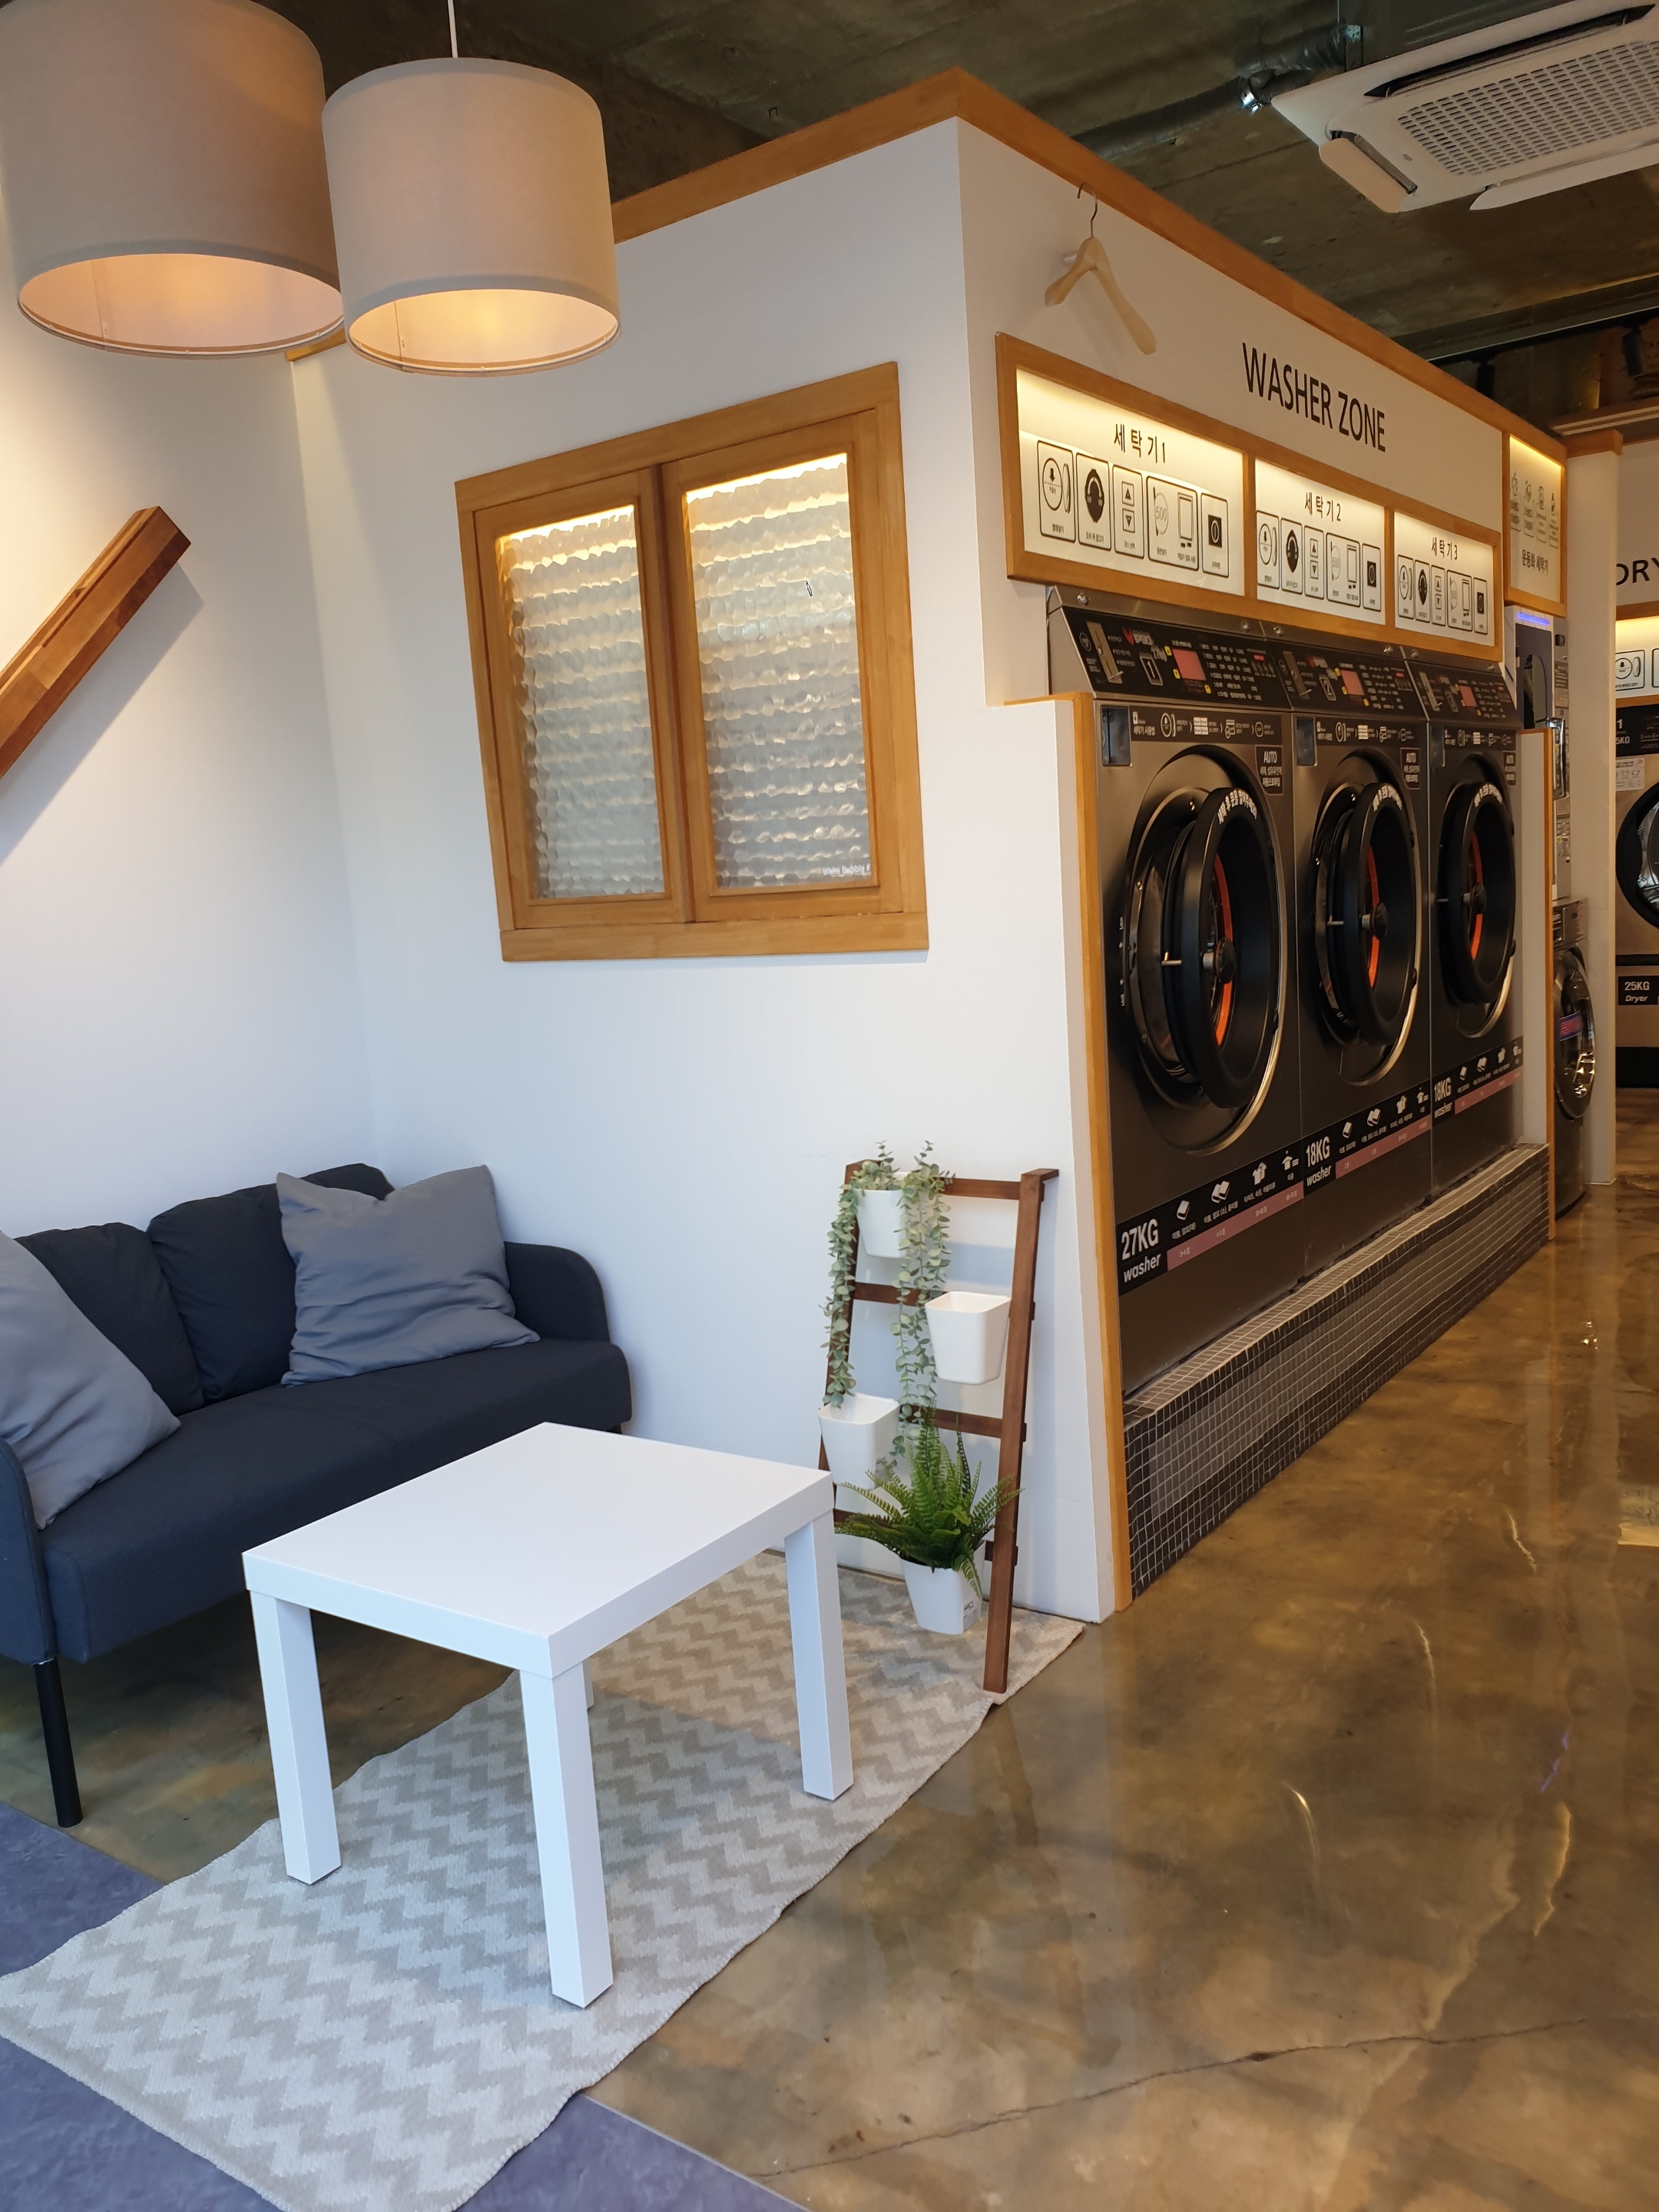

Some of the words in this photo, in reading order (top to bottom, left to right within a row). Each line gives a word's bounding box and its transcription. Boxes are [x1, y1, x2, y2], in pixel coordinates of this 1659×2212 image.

[1242, 342, 1333, 429] WASHER
[1338, 390, 1386, 452] ZONE
[1522, 548, 1535, 570] 운동화
[1263, 750, 1277, 764] AUTO
[1229, 790, 1239, 807] 문을
[1624, 981, 1651, 991] 25KG
[1625, 995, 1648, 1004] Dryer
[1433, 1077, 1452, 1102] 18KG
[1306, 1136, 1330, 1167] 18KG
[1306, 1164, 1332, 1187] washer
[1121, 1218, 1160, 1260] 27KG
[1123, 1253, 1161, 1283] washer
